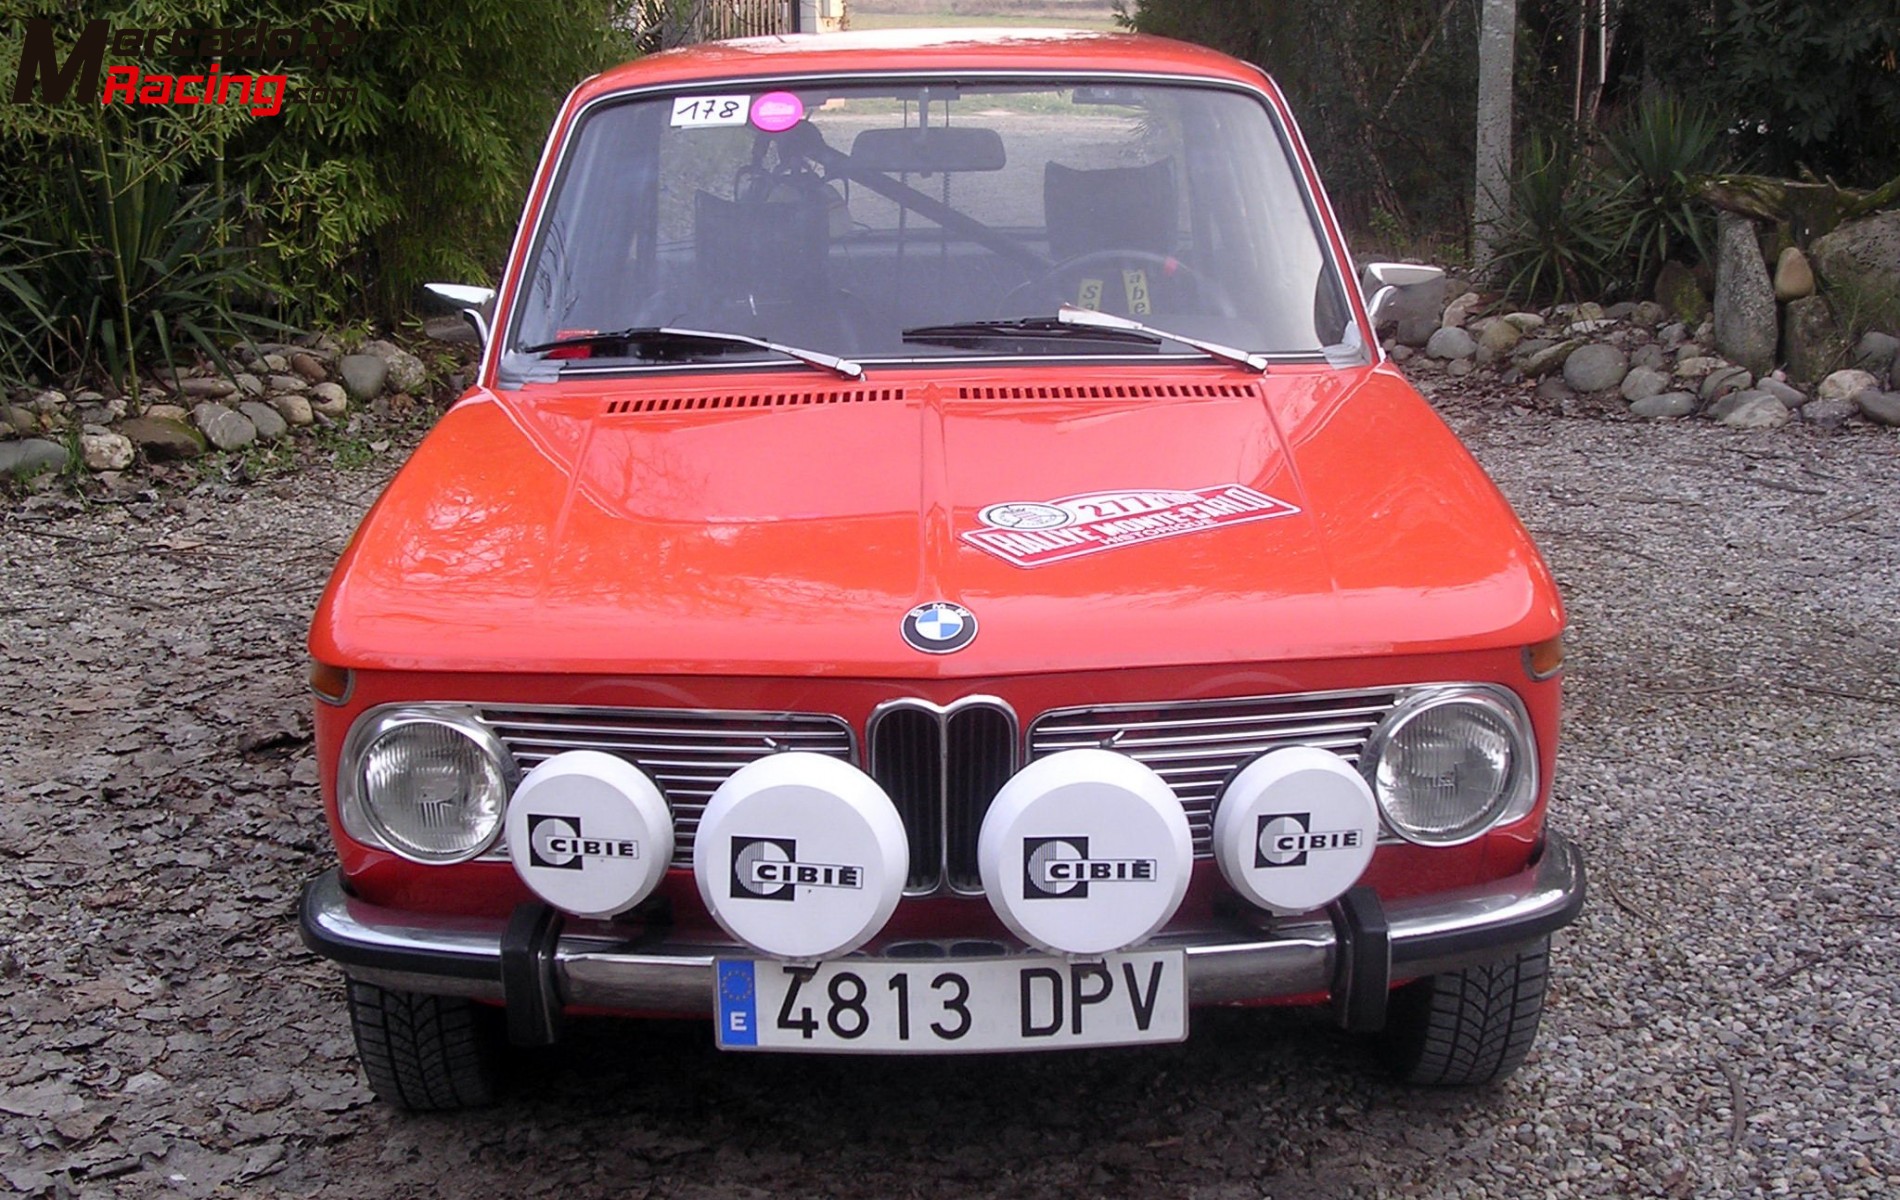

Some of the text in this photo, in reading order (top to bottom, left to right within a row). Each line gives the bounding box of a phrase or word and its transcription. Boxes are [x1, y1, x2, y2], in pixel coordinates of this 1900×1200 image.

[677, 100, 739, 119] 178
[1078, 496, 1152, 517] 277
[976, 525, 1102, 557] RALLYE
[1090, 487, 1275, 538] MONTE-CARLO
[1100, 518, 1218, 545] HISTORIQUE
[910, 603, 970, 617] BMW
[777, 960, 1165, 1040] 4813 DPV
[730, 1012, 746, 1031] E
